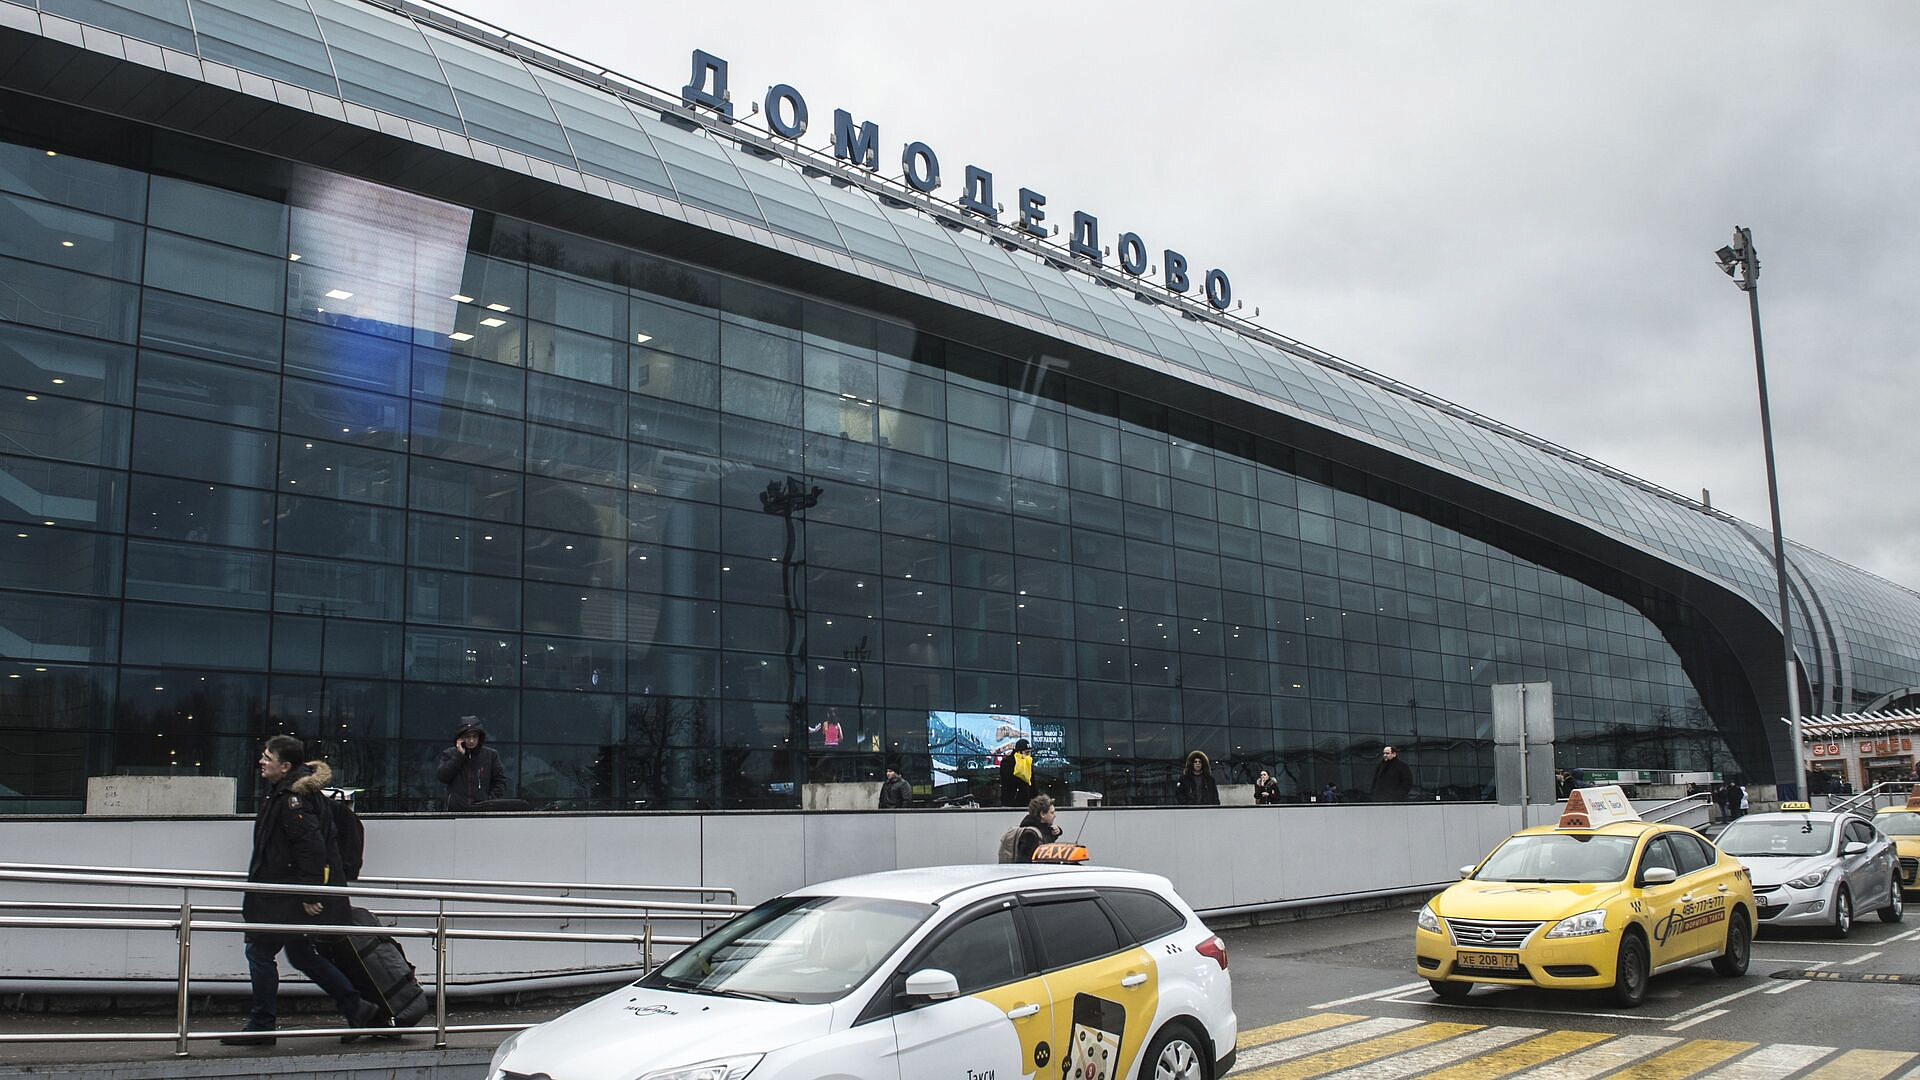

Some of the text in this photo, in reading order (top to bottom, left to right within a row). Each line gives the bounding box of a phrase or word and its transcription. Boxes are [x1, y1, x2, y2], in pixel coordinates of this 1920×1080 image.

[682, 48, 1232, 310] ДОМОДЕДОВО
[1037, 845, 1072, 860] TAXI
[1479, 954, 1498, 966] 208
[1503, 955, 1514, 964] 77
[966, 1069, 995, 1080] Такси
